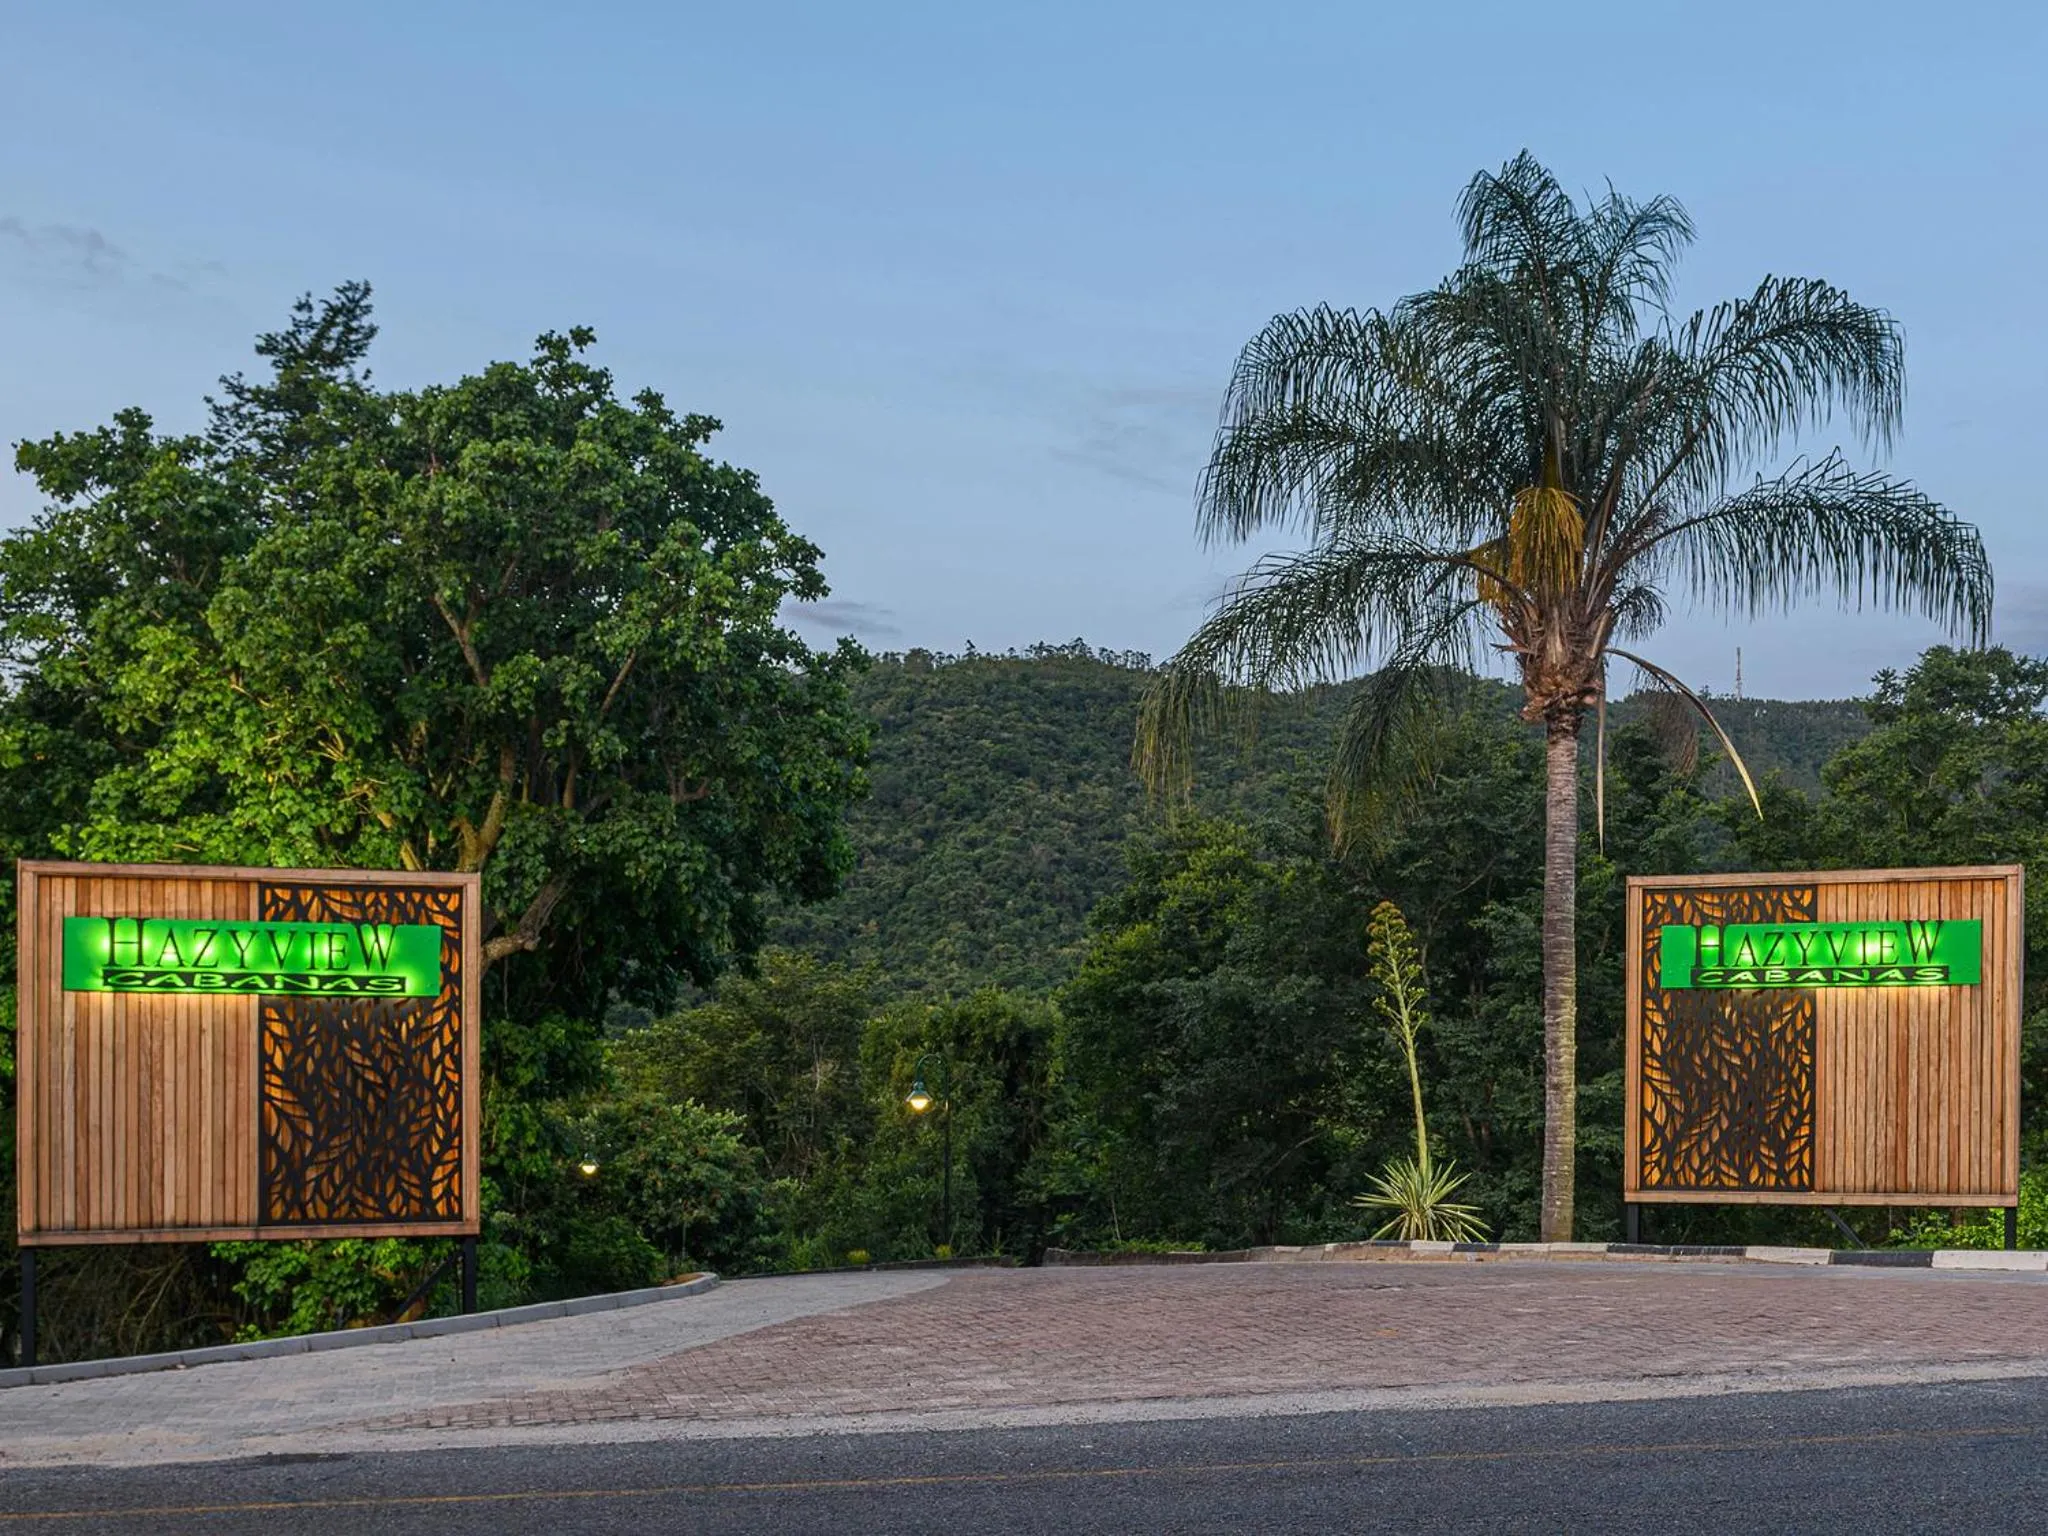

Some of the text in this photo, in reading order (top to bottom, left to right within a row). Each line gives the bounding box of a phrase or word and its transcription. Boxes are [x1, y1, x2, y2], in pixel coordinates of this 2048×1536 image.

[106, 917, 399, 972] HAZYVIEW
[1694, 920, 1945, 968] HAZYVIEW
[106, 972, 403, 992] CABANAS
[1697, 967, 1945, 984] CABANAS
